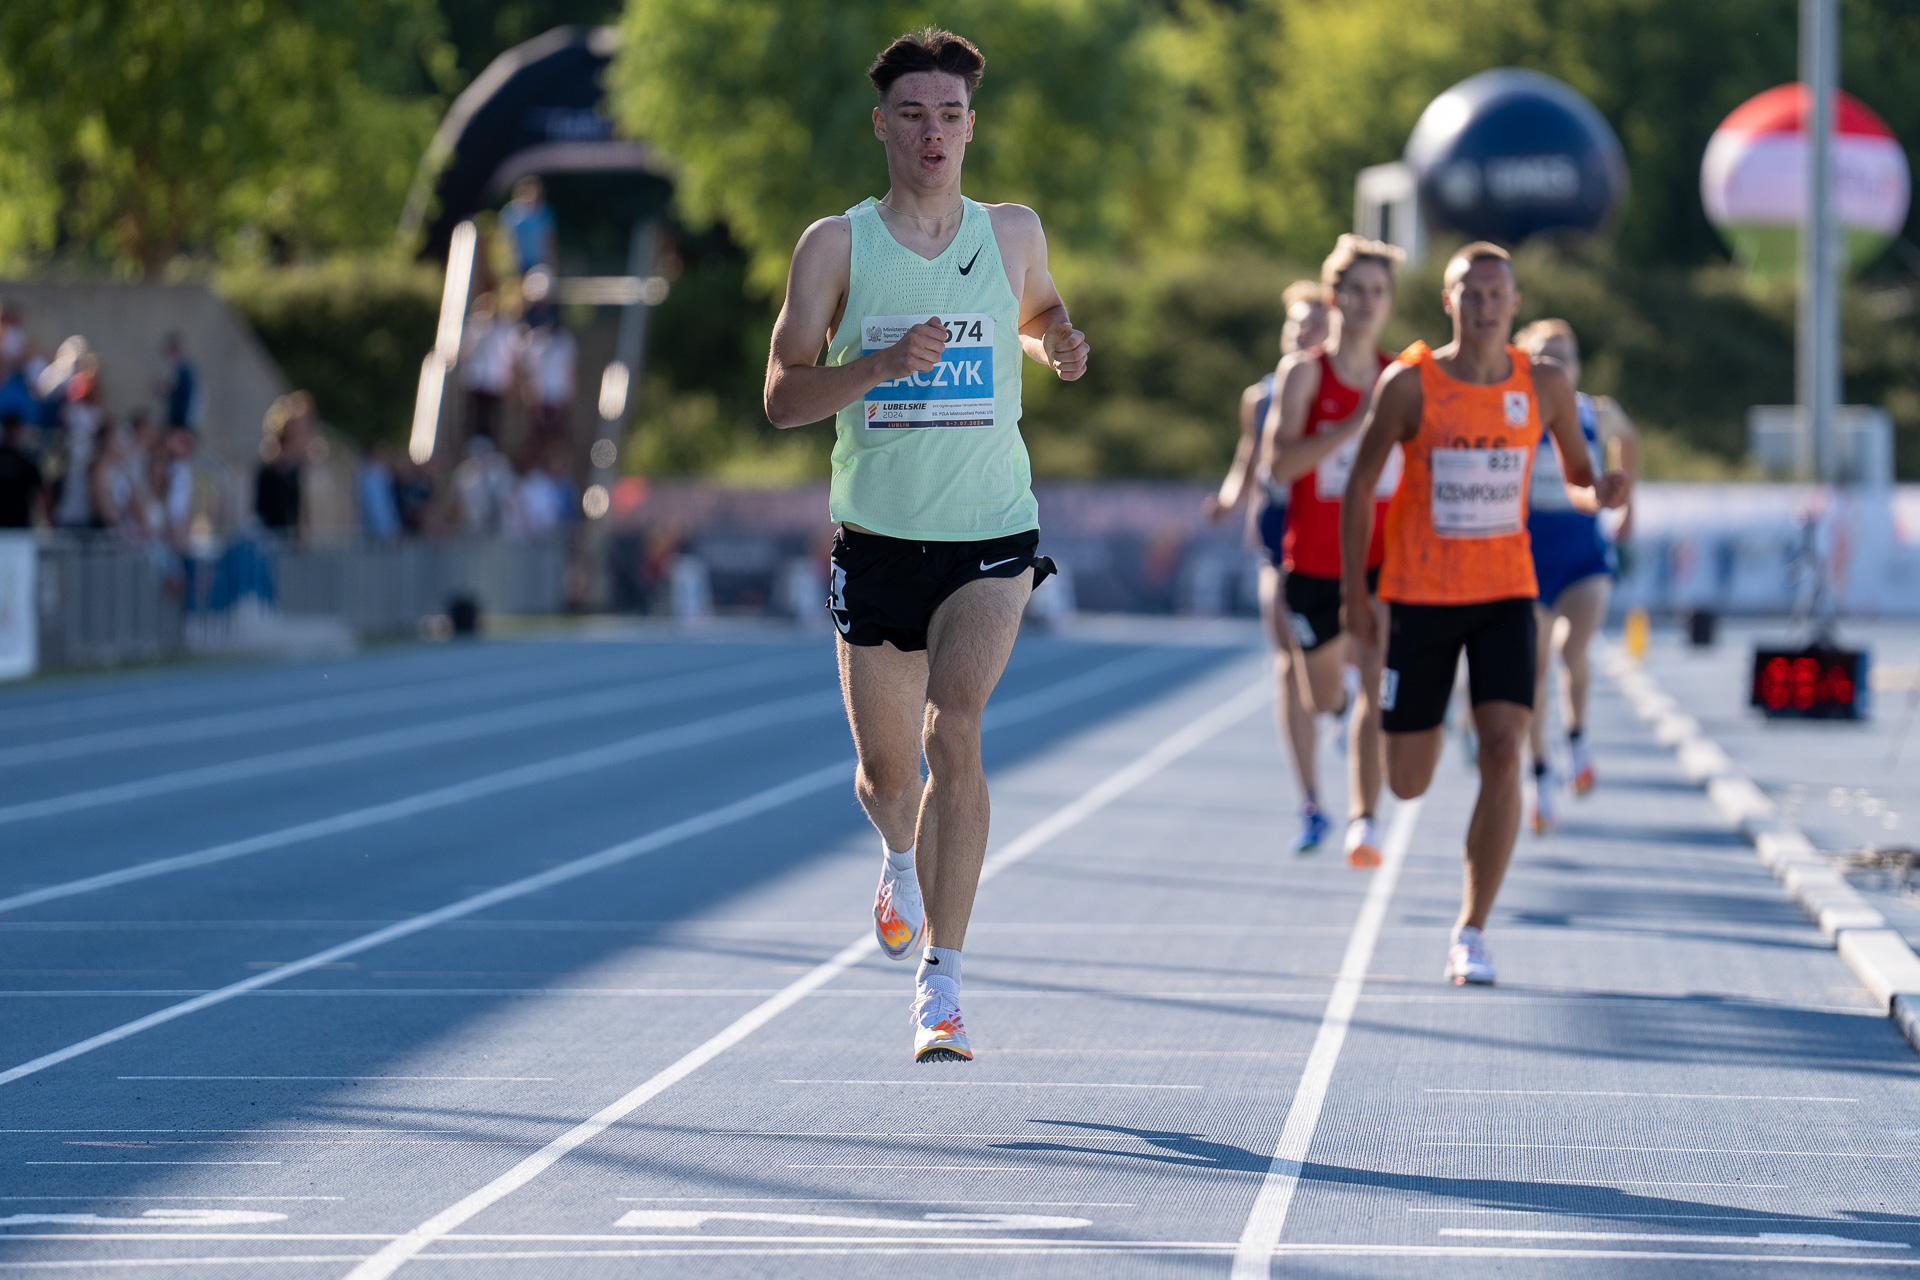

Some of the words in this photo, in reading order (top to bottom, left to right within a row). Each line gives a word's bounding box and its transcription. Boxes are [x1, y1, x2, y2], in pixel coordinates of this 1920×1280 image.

[876, 360, 984, 388] ACZYK
[883, 403, 927, 411] LUBELSKIE
[882, 411, 903, 419] 2024
